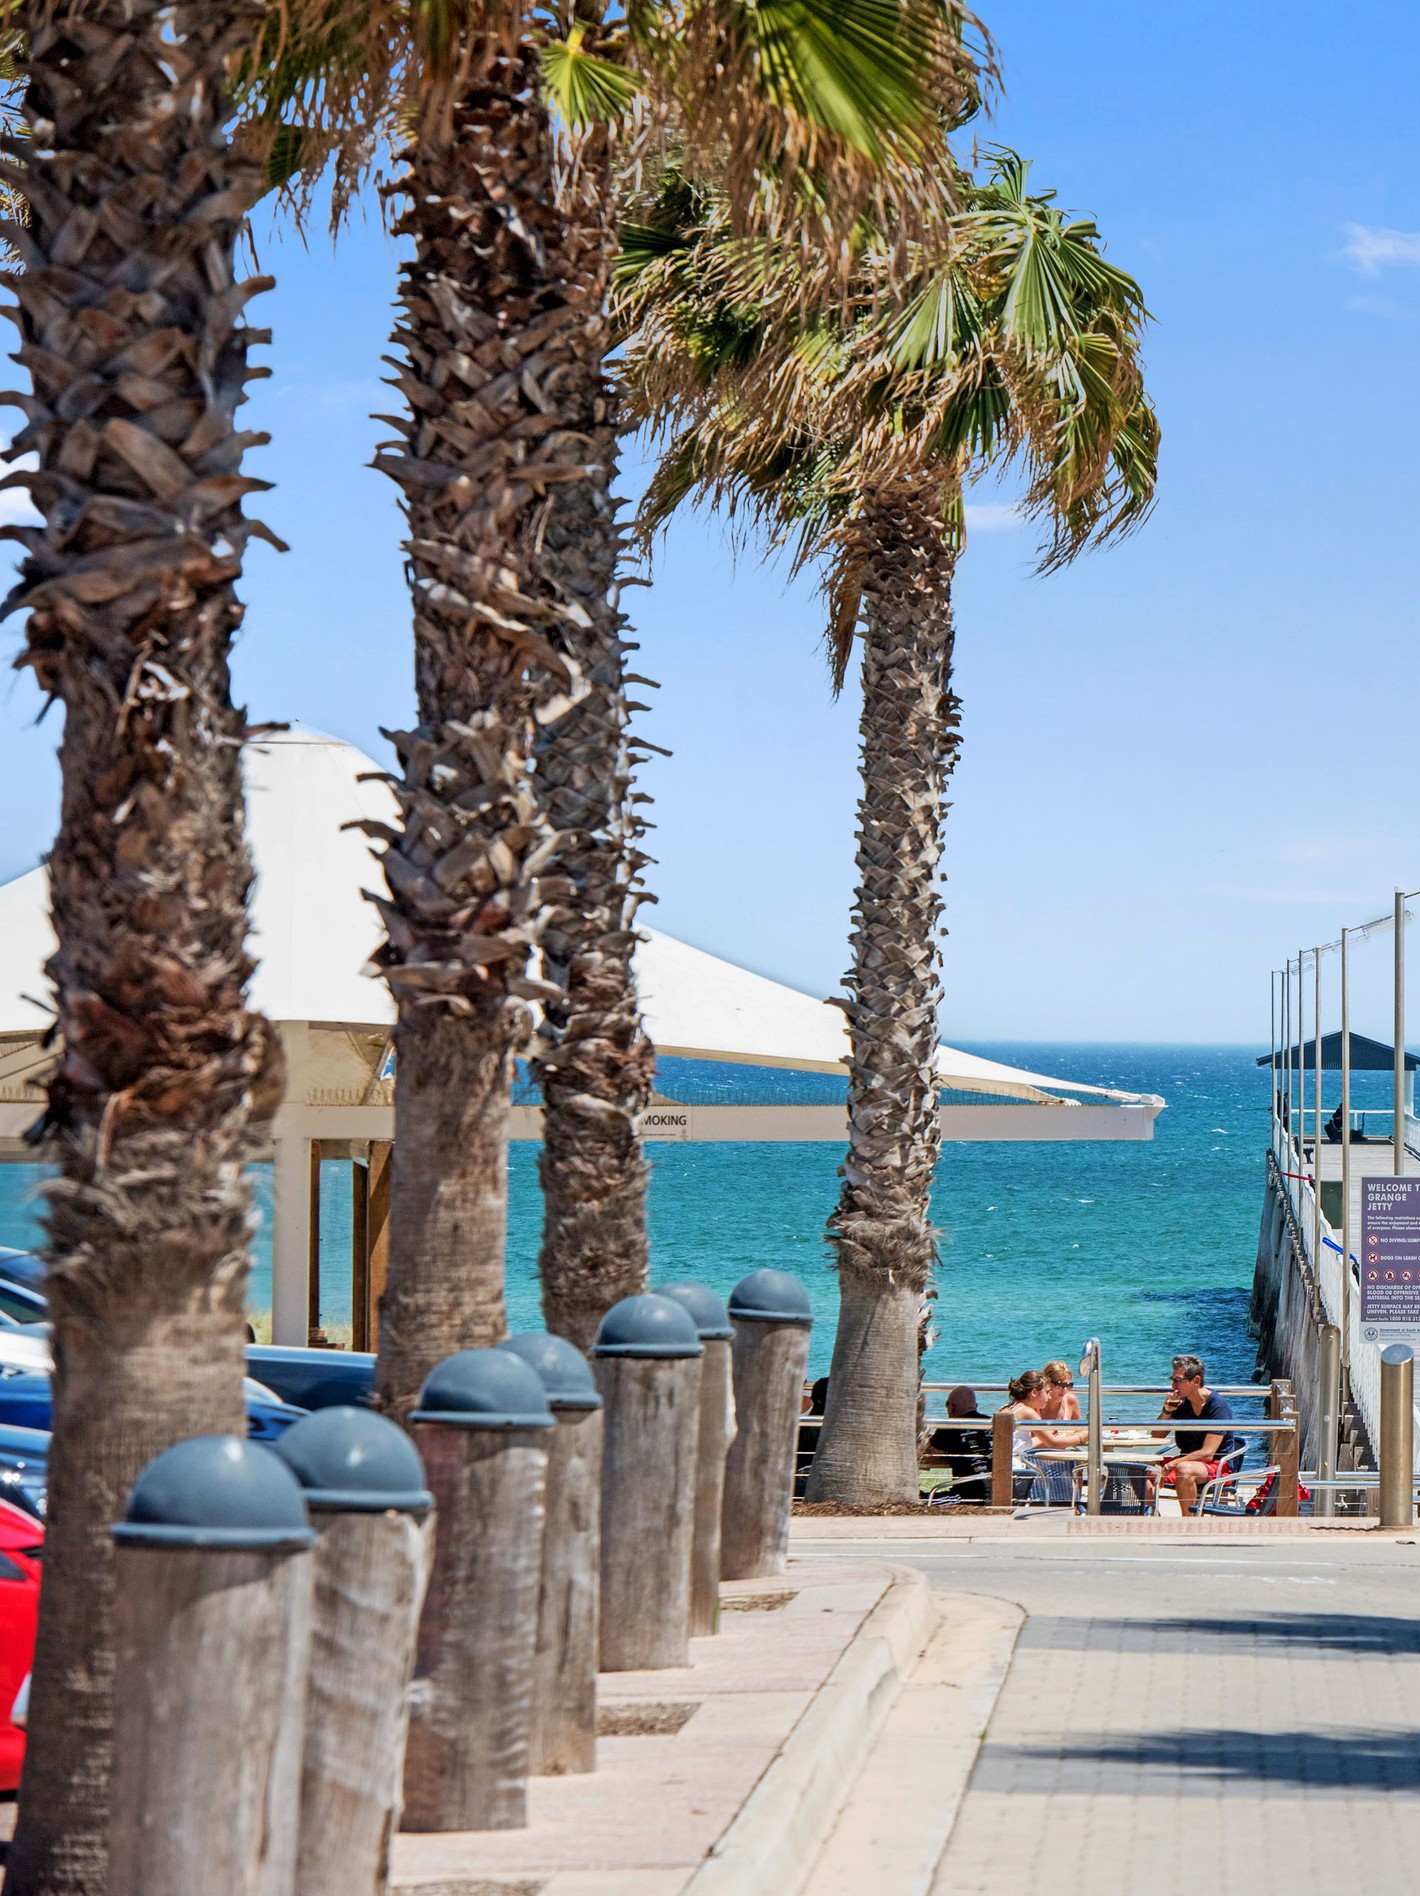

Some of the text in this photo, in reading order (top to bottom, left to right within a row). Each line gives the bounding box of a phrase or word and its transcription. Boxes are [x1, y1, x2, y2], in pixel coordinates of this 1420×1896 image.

[641, 1115, 687, 1126] MOKING
[1367, 1184, 1412, 1192] WELCOME
[1367, 1193, 1407, 1201] GRANGE
[1367, 1203, 1393, 1211] JETTY
